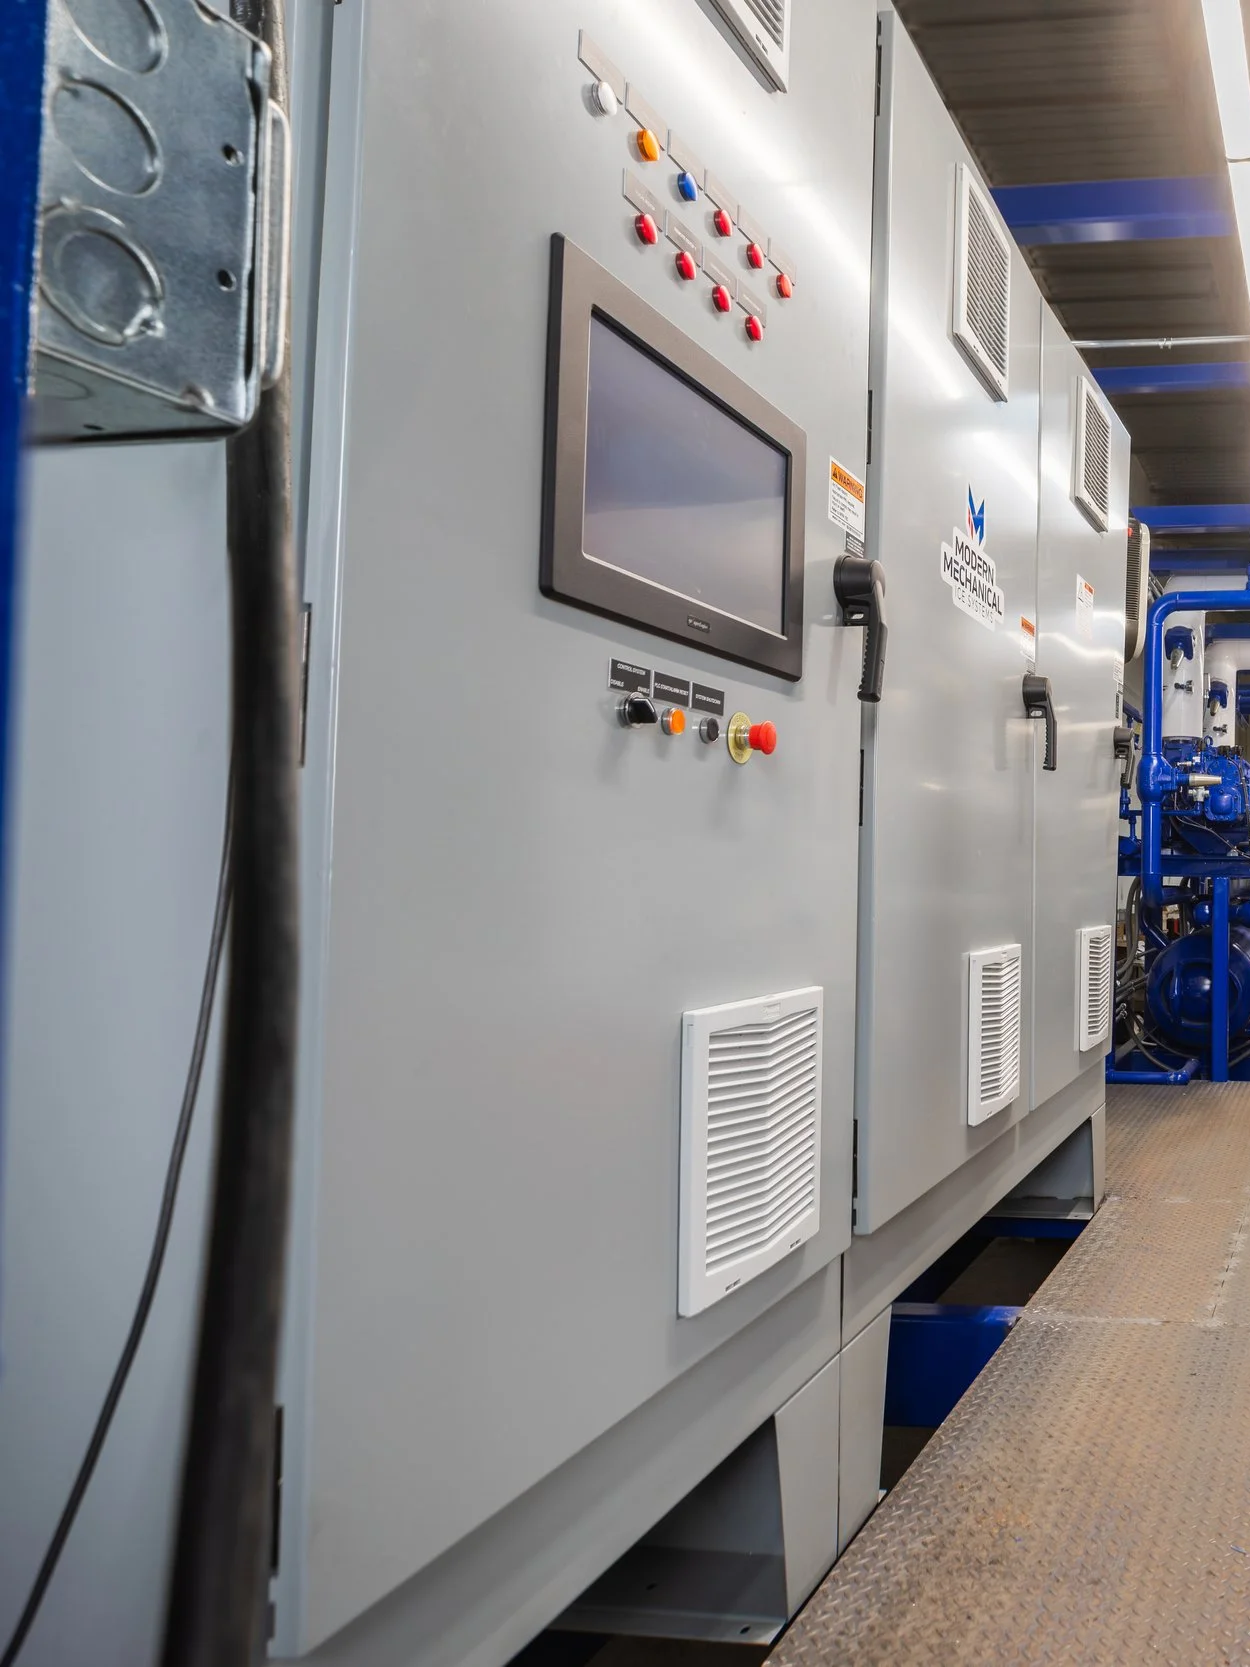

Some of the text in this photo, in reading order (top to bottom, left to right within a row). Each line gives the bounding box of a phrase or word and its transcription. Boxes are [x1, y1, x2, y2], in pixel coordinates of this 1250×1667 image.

[838, 470, 863, 499] WARNING
[955, 535, 995, 587] MODERN
[943, 551, 1003, 616] MECHANICAL
[954, 585, 994, 624] ICE SYSTEMS
[617, 663, 646, 675] CONTROL SYSTEM
